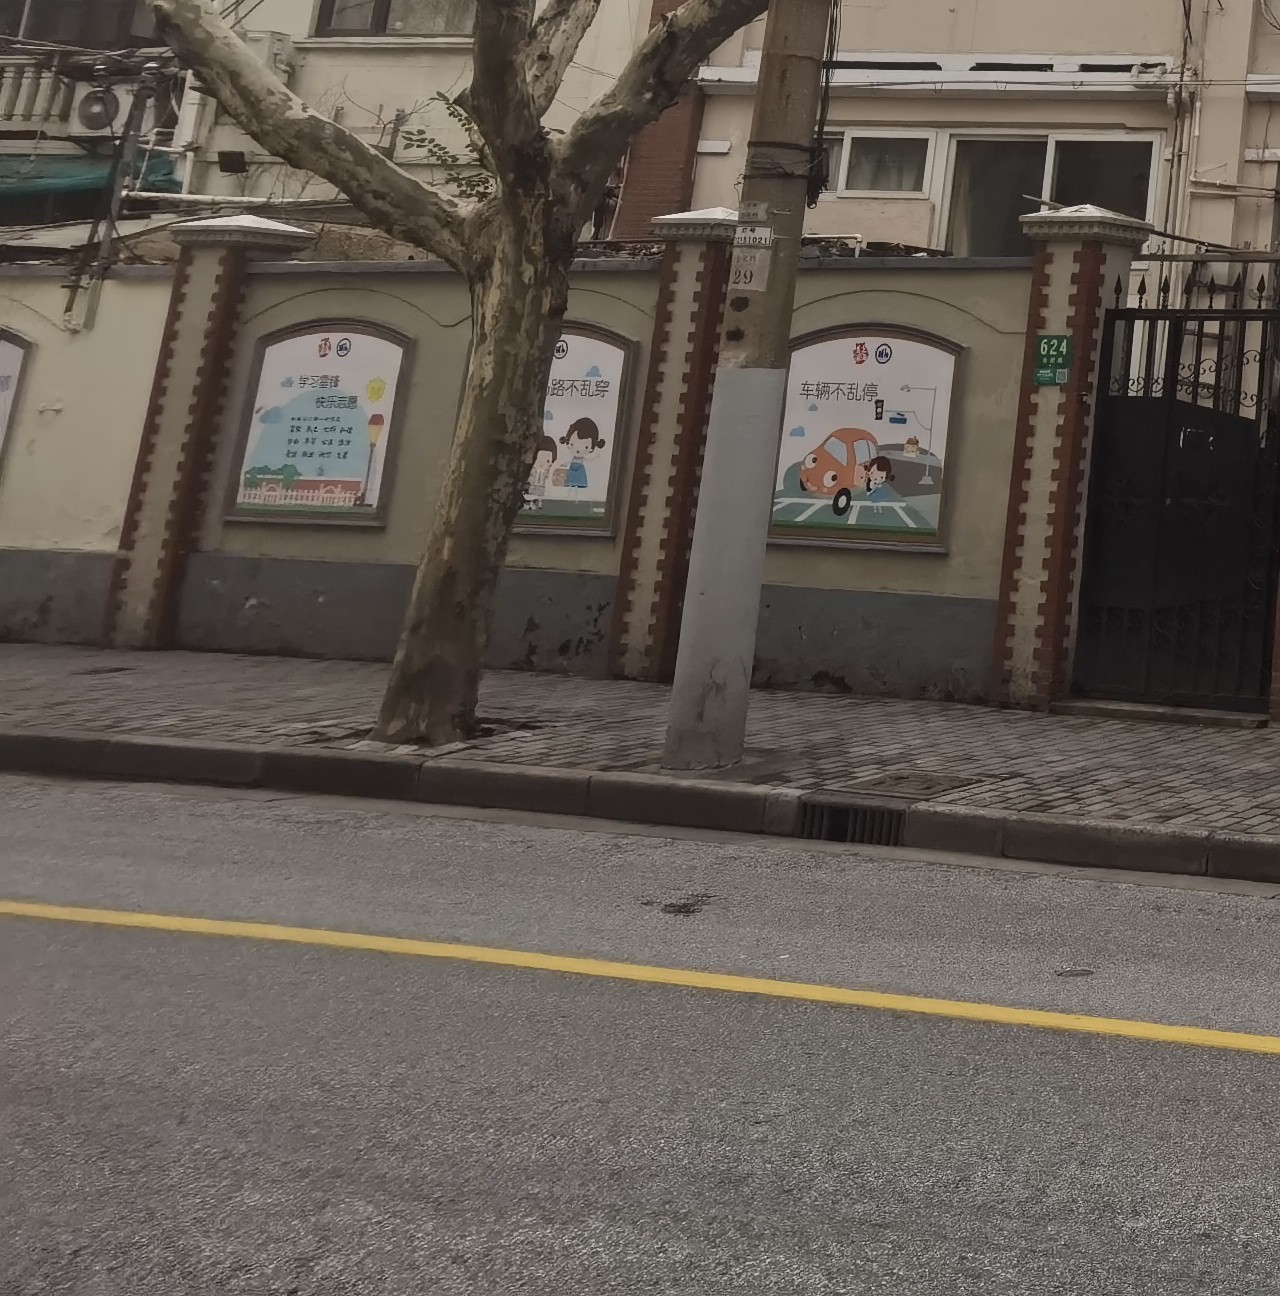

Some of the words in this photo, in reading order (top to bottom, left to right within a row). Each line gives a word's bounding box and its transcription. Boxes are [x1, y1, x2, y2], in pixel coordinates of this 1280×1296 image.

[732, 270, 754, 285] 29
[1040, 338, 1067, 355] 624
[799, 380, 879, 403] 车辆不乱停
